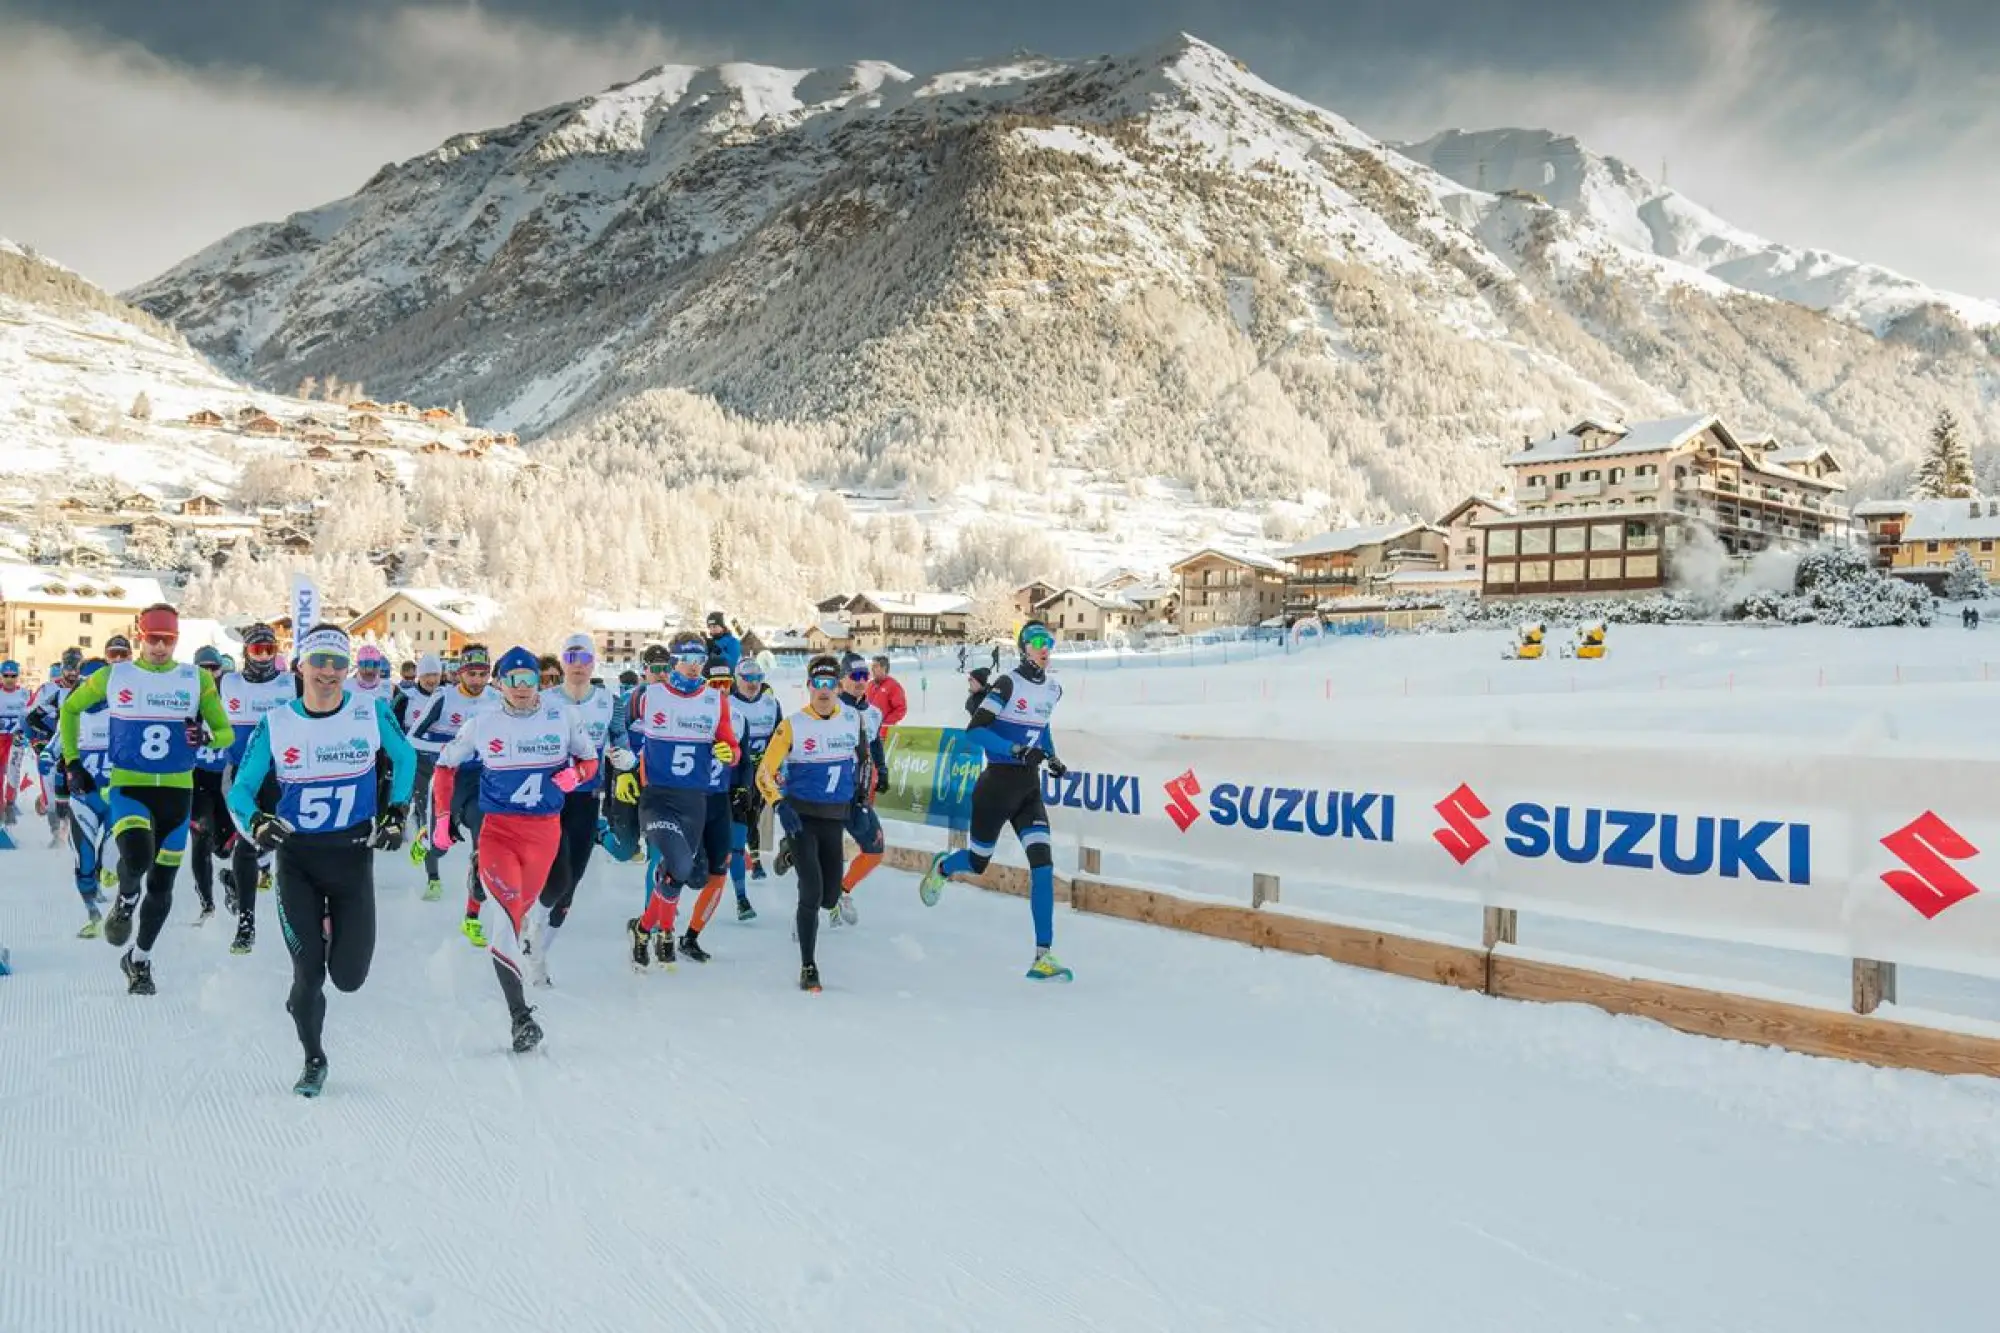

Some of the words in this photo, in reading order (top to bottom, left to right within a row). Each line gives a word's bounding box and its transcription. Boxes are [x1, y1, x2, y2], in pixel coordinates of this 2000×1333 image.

[140, 724, 171, 760] 8
[671, 744, 696, 776] 5
[509, 772, 544, 809] 4
[825, 765, 842, 794] 1
[937, 734, 981, 804] Cogn
[297, 784, 358, 829] 51
[1040, 769, 1141, 815] UZUKI
[1209, 782, 1395, 842] SUZUKI
[1504, 802, 1811, 886] SUZUKI
